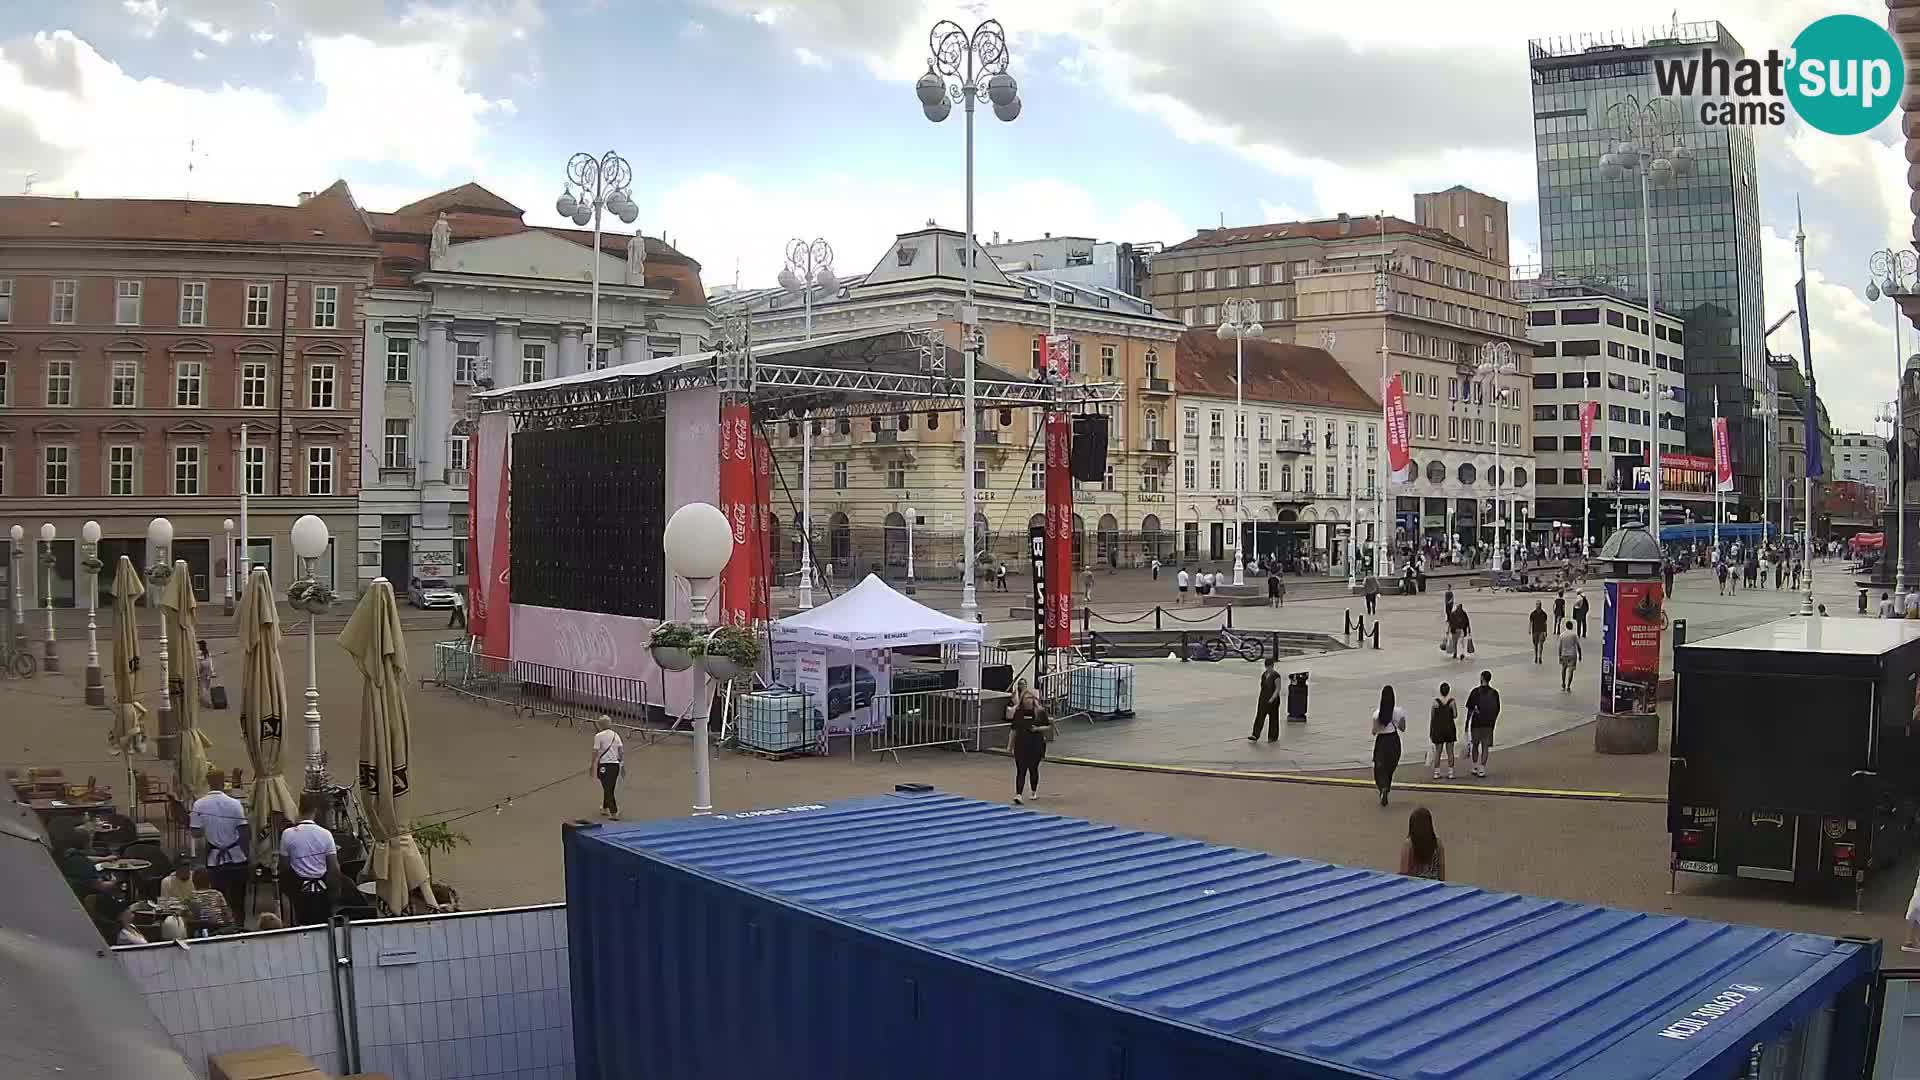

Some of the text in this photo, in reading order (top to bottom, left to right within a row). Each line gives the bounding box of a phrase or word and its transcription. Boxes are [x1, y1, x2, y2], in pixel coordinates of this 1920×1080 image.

[960, 491, 996, 501] SGER
[1658, 1017, 1708, 1040] MCDU
[1691, 991, 1746, 1020] 300629
